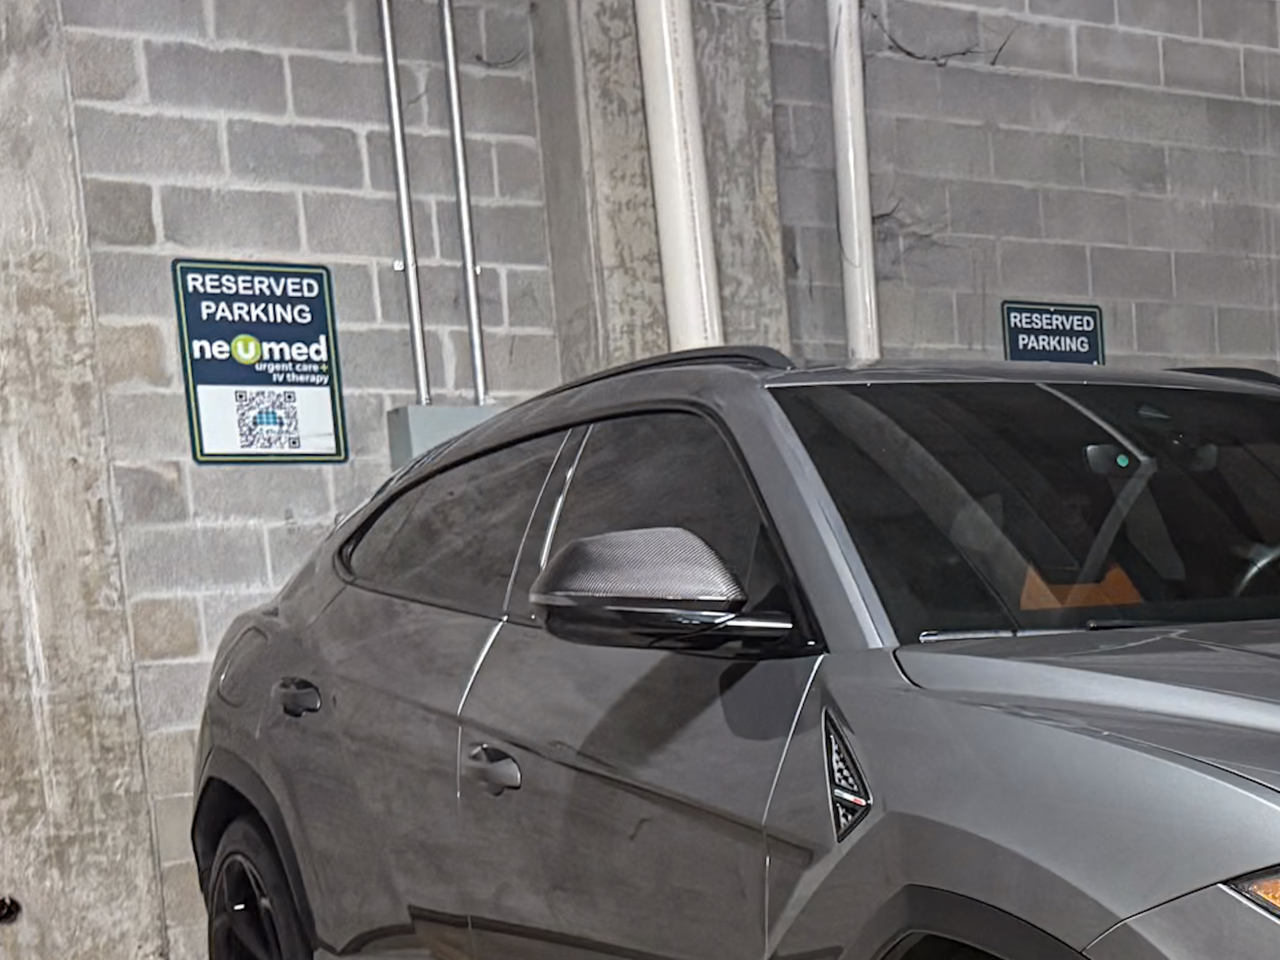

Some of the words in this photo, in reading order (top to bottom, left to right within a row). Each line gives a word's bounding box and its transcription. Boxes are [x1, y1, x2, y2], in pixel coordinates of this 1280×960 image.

[186, 273, 319, 297] RESERVED
[201, 301, 312, 324] PARKING
[1010, 312, 1095, 332] RESERVED
[192, 334, 328, 364] neumed
[1018, 334, 1089, 352] PARKING
[255, 362, 293, 374] urgent
[295, 363, 319, 372] care
[272, 373, 285, 383] IV
[286, 372, 329, 385] therapy
